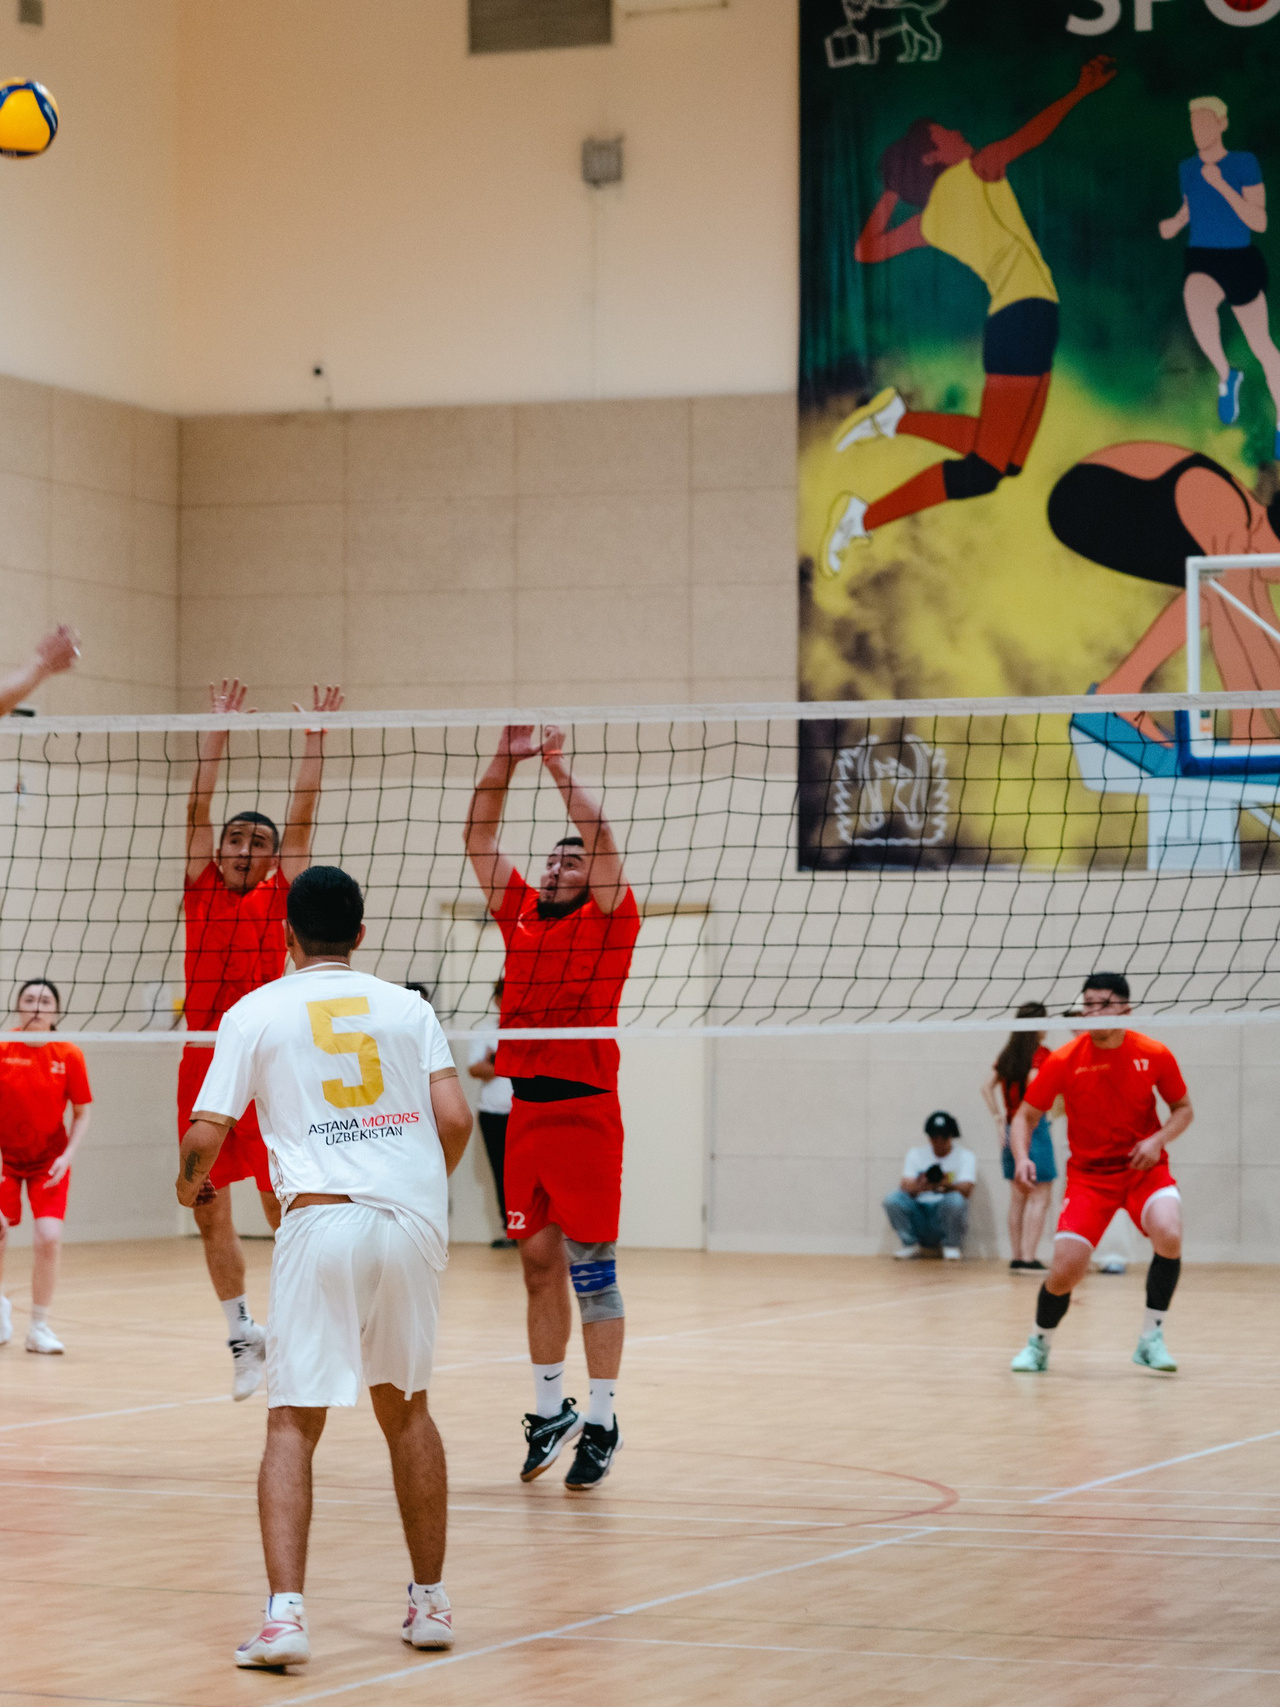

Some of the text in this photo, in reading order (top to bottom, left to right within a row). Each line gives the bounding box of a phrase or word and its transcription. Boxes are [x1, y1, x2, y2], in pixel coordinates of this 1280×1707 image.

[306, 996, 384, 1109] 5
[308, 1111, 420, 1136] ASTANA MOTORS
[325, 1126, 402, 1146] UZBEKISTAN
